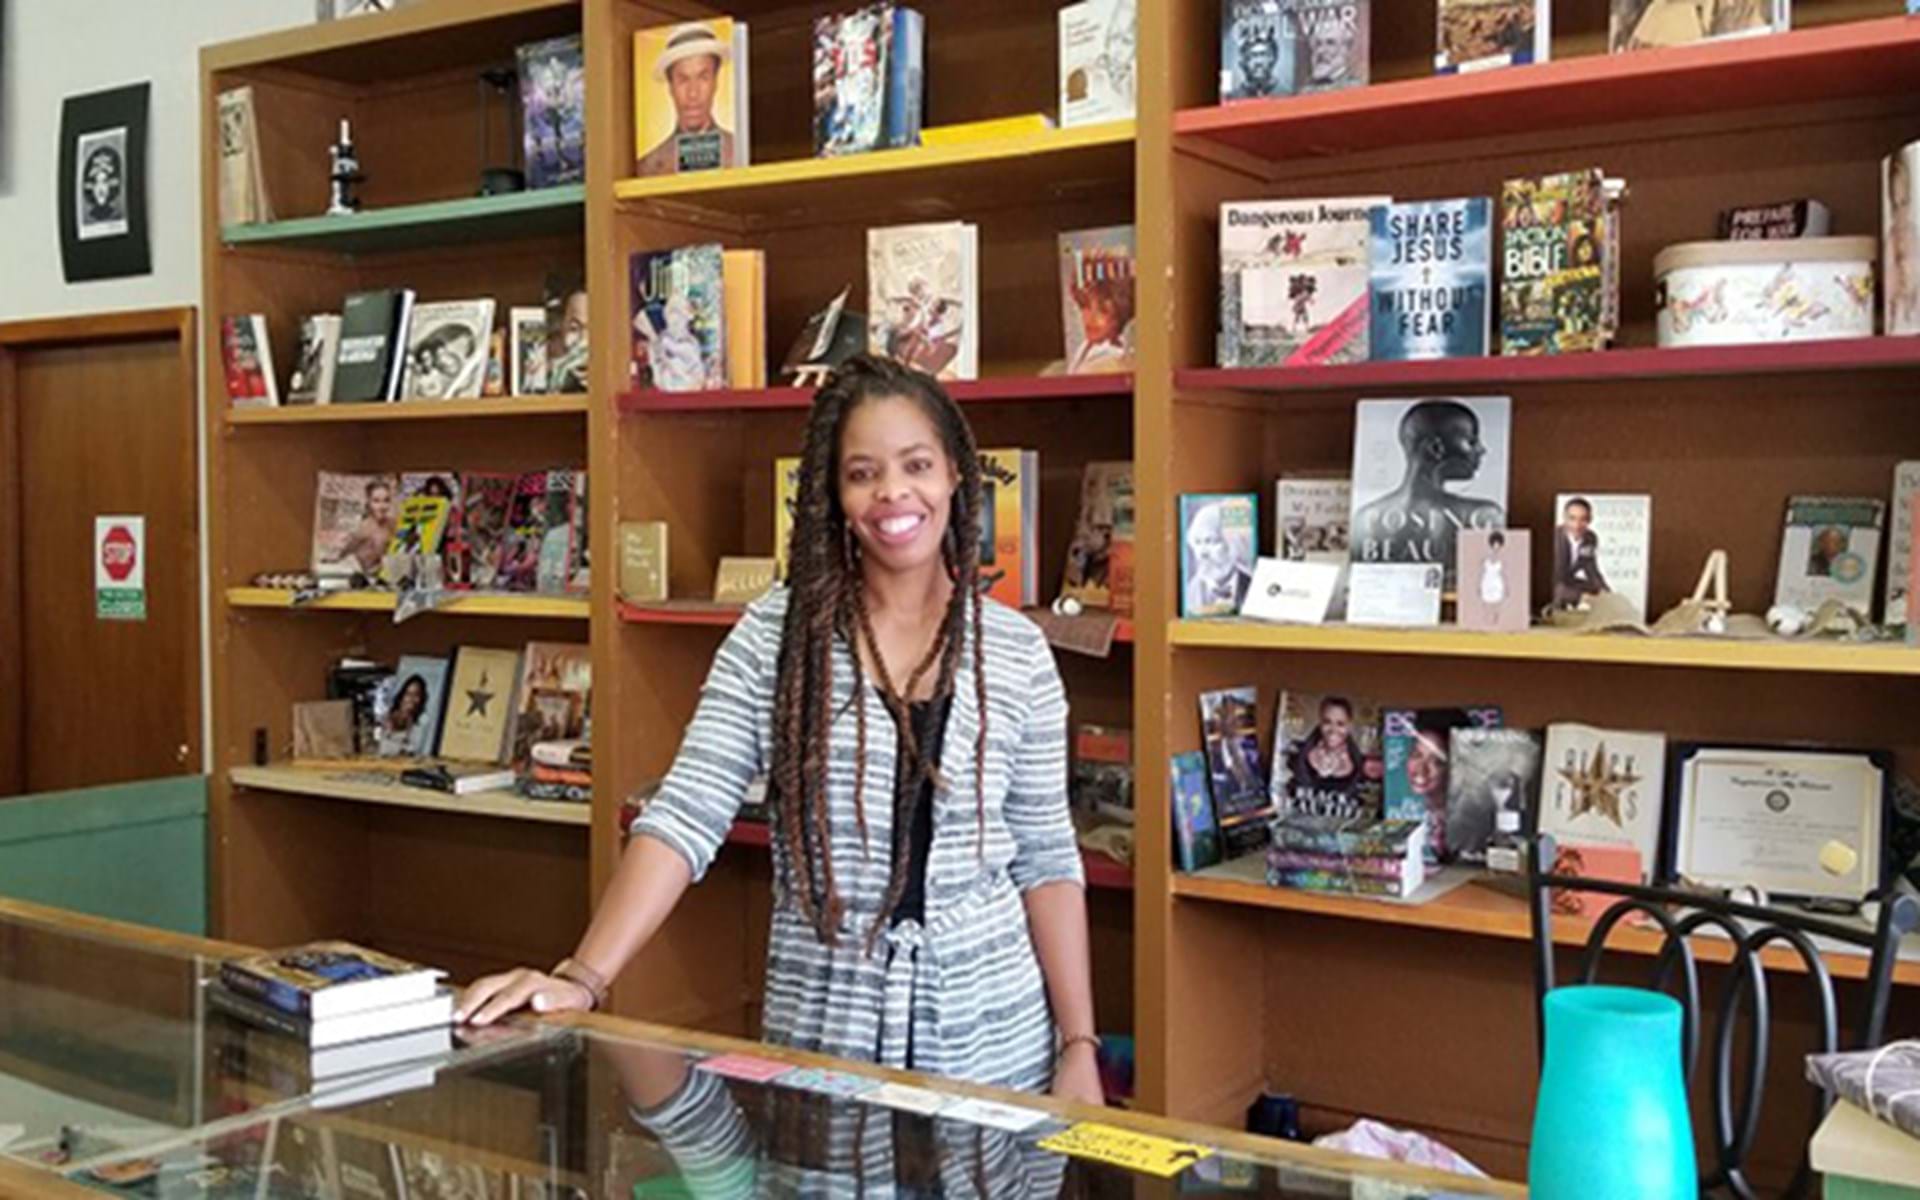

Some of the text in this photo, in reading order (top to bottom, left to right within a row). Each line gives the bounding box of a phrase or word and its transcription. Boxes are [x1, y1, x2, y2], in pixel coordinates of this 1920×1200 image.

[1301, 5, 1357, 36] WAR
[1228, 206, 1313, 228] Dangerous
[1391, 210, 1464, 240] SHARE
[1392, 236, 1463, 264] JESUS
[1505, 243, 1567, 279] BIBLE
[1400, 314, 1456, 346] FEAR
[1364, 506, 1500, 532] POSING
[103, 541, 135, 565] STOP
[1385, 708, 1500, 737] ESCE
[1564, 748, 1636, 778] BLCK
[1296, 786, 1345, 808] BLACK
